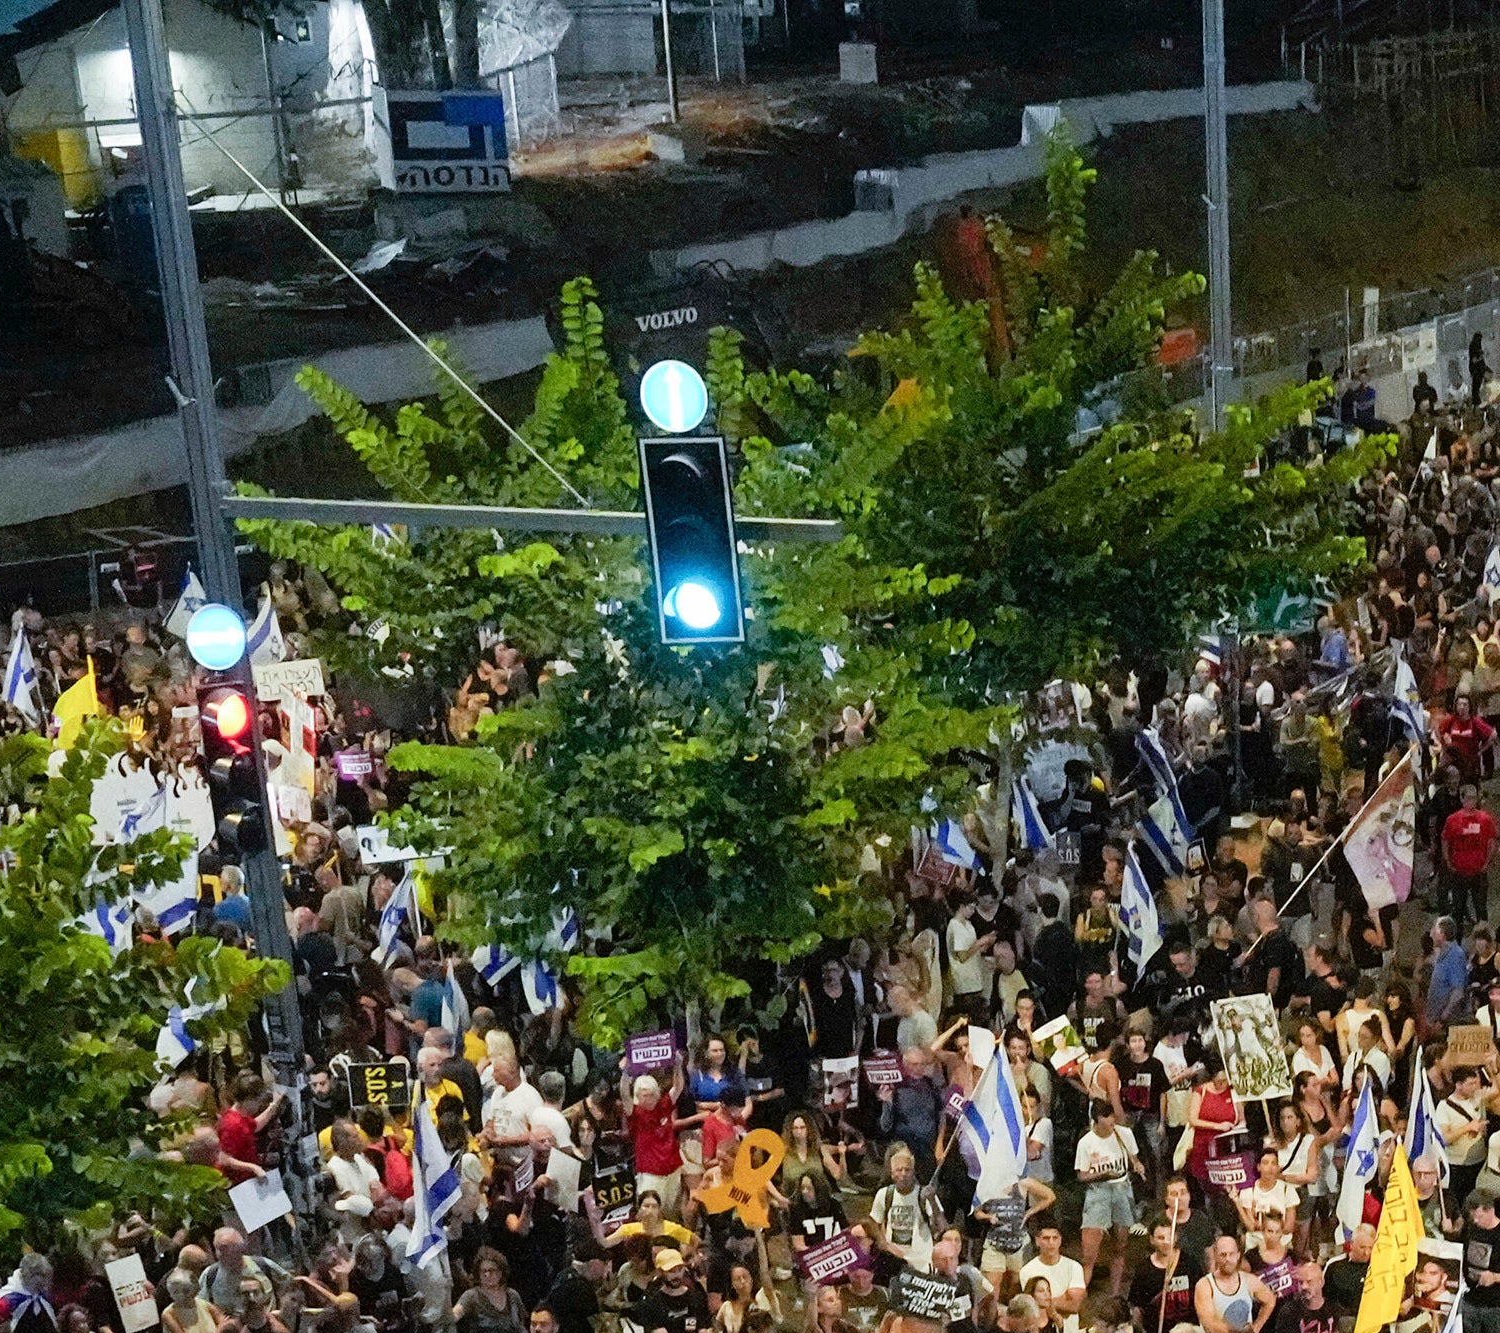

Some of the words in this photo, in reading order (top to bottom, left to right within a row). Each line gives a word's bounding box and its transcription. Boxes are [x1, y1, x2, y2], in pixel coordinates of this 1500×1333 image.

[634, 306, 698, 333] VOLVO
[634, 1047, 670, 1062] עכשיו
[813, 1252, 857, 1280] עכשיו
